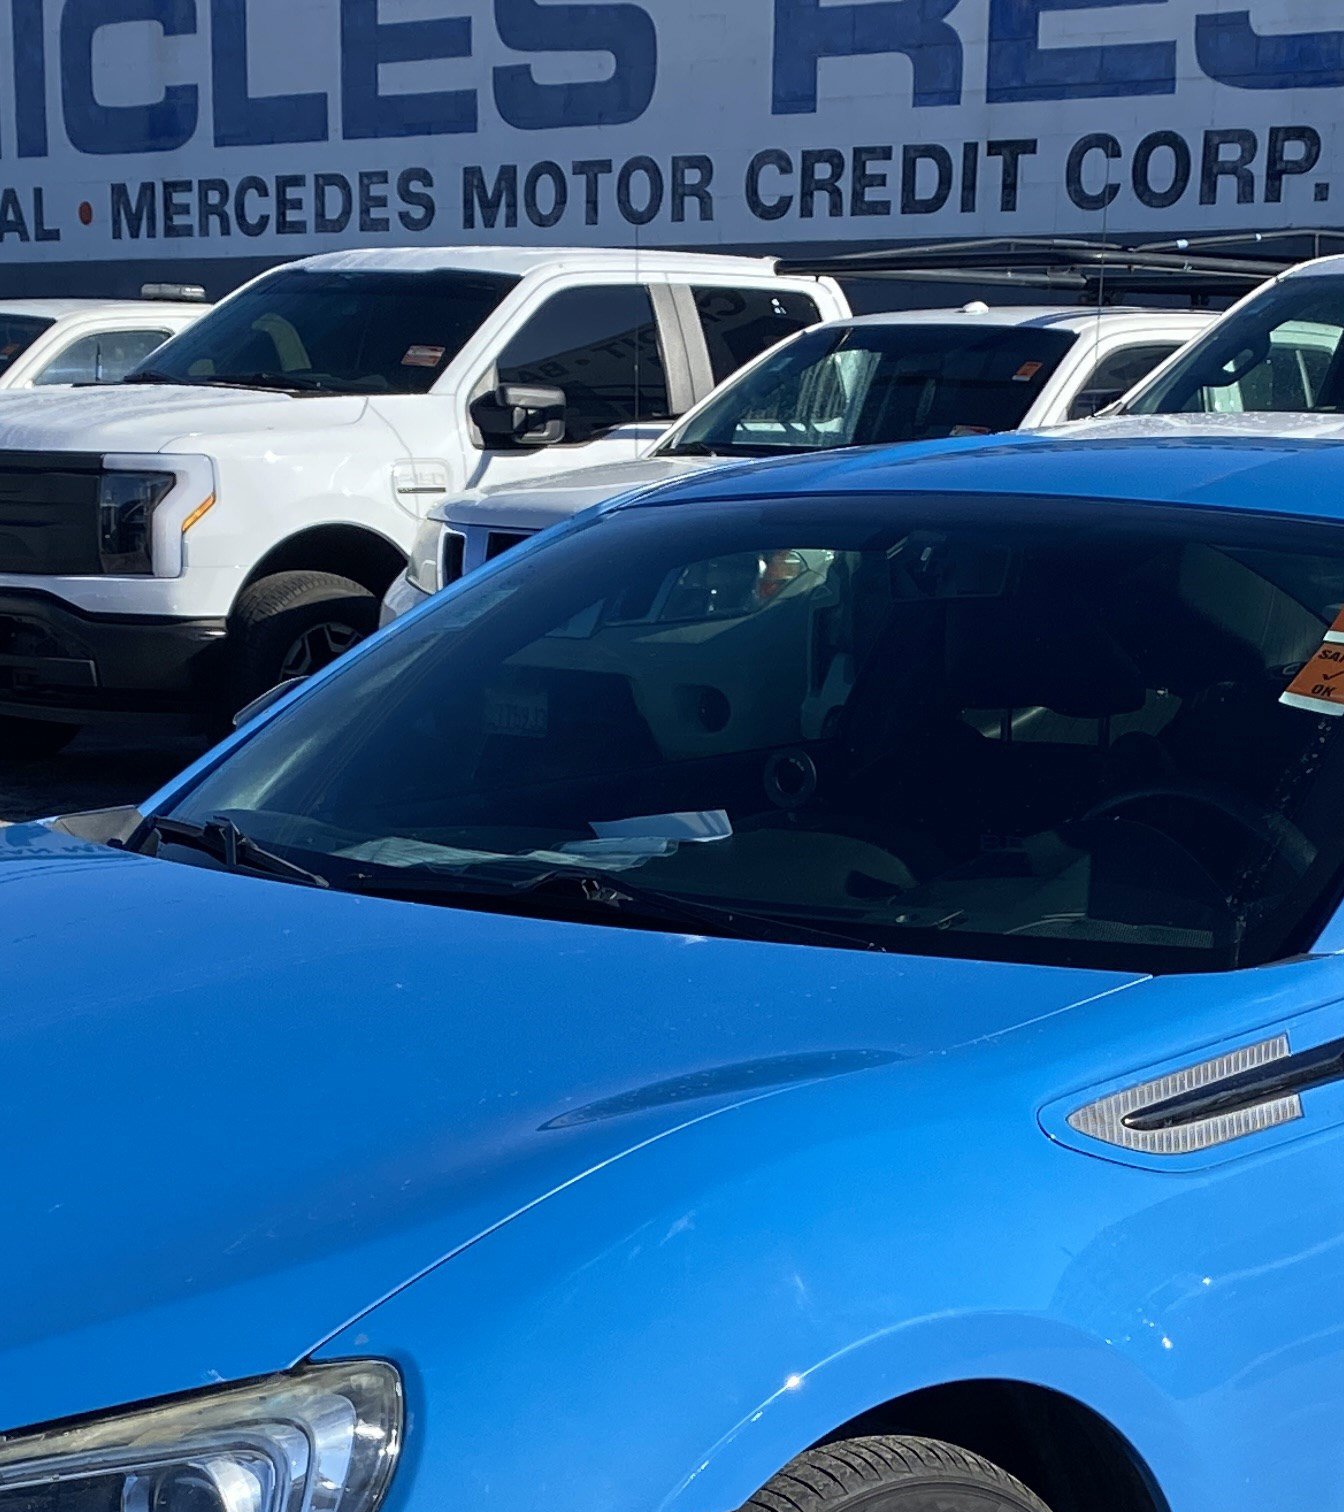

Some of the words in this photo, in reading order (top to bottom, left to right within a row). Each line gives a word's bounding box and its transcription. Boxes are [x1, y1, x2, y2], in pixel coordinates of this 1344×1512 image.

[110, 167, 436, 241] MERCEDES
[462, 154, 714, 230] MOTOR
[745, 138, 1038, 221] CREDIT
[1065, 125, 1330, 212] CORP.
[1311, 683, 1337, 698] OK
